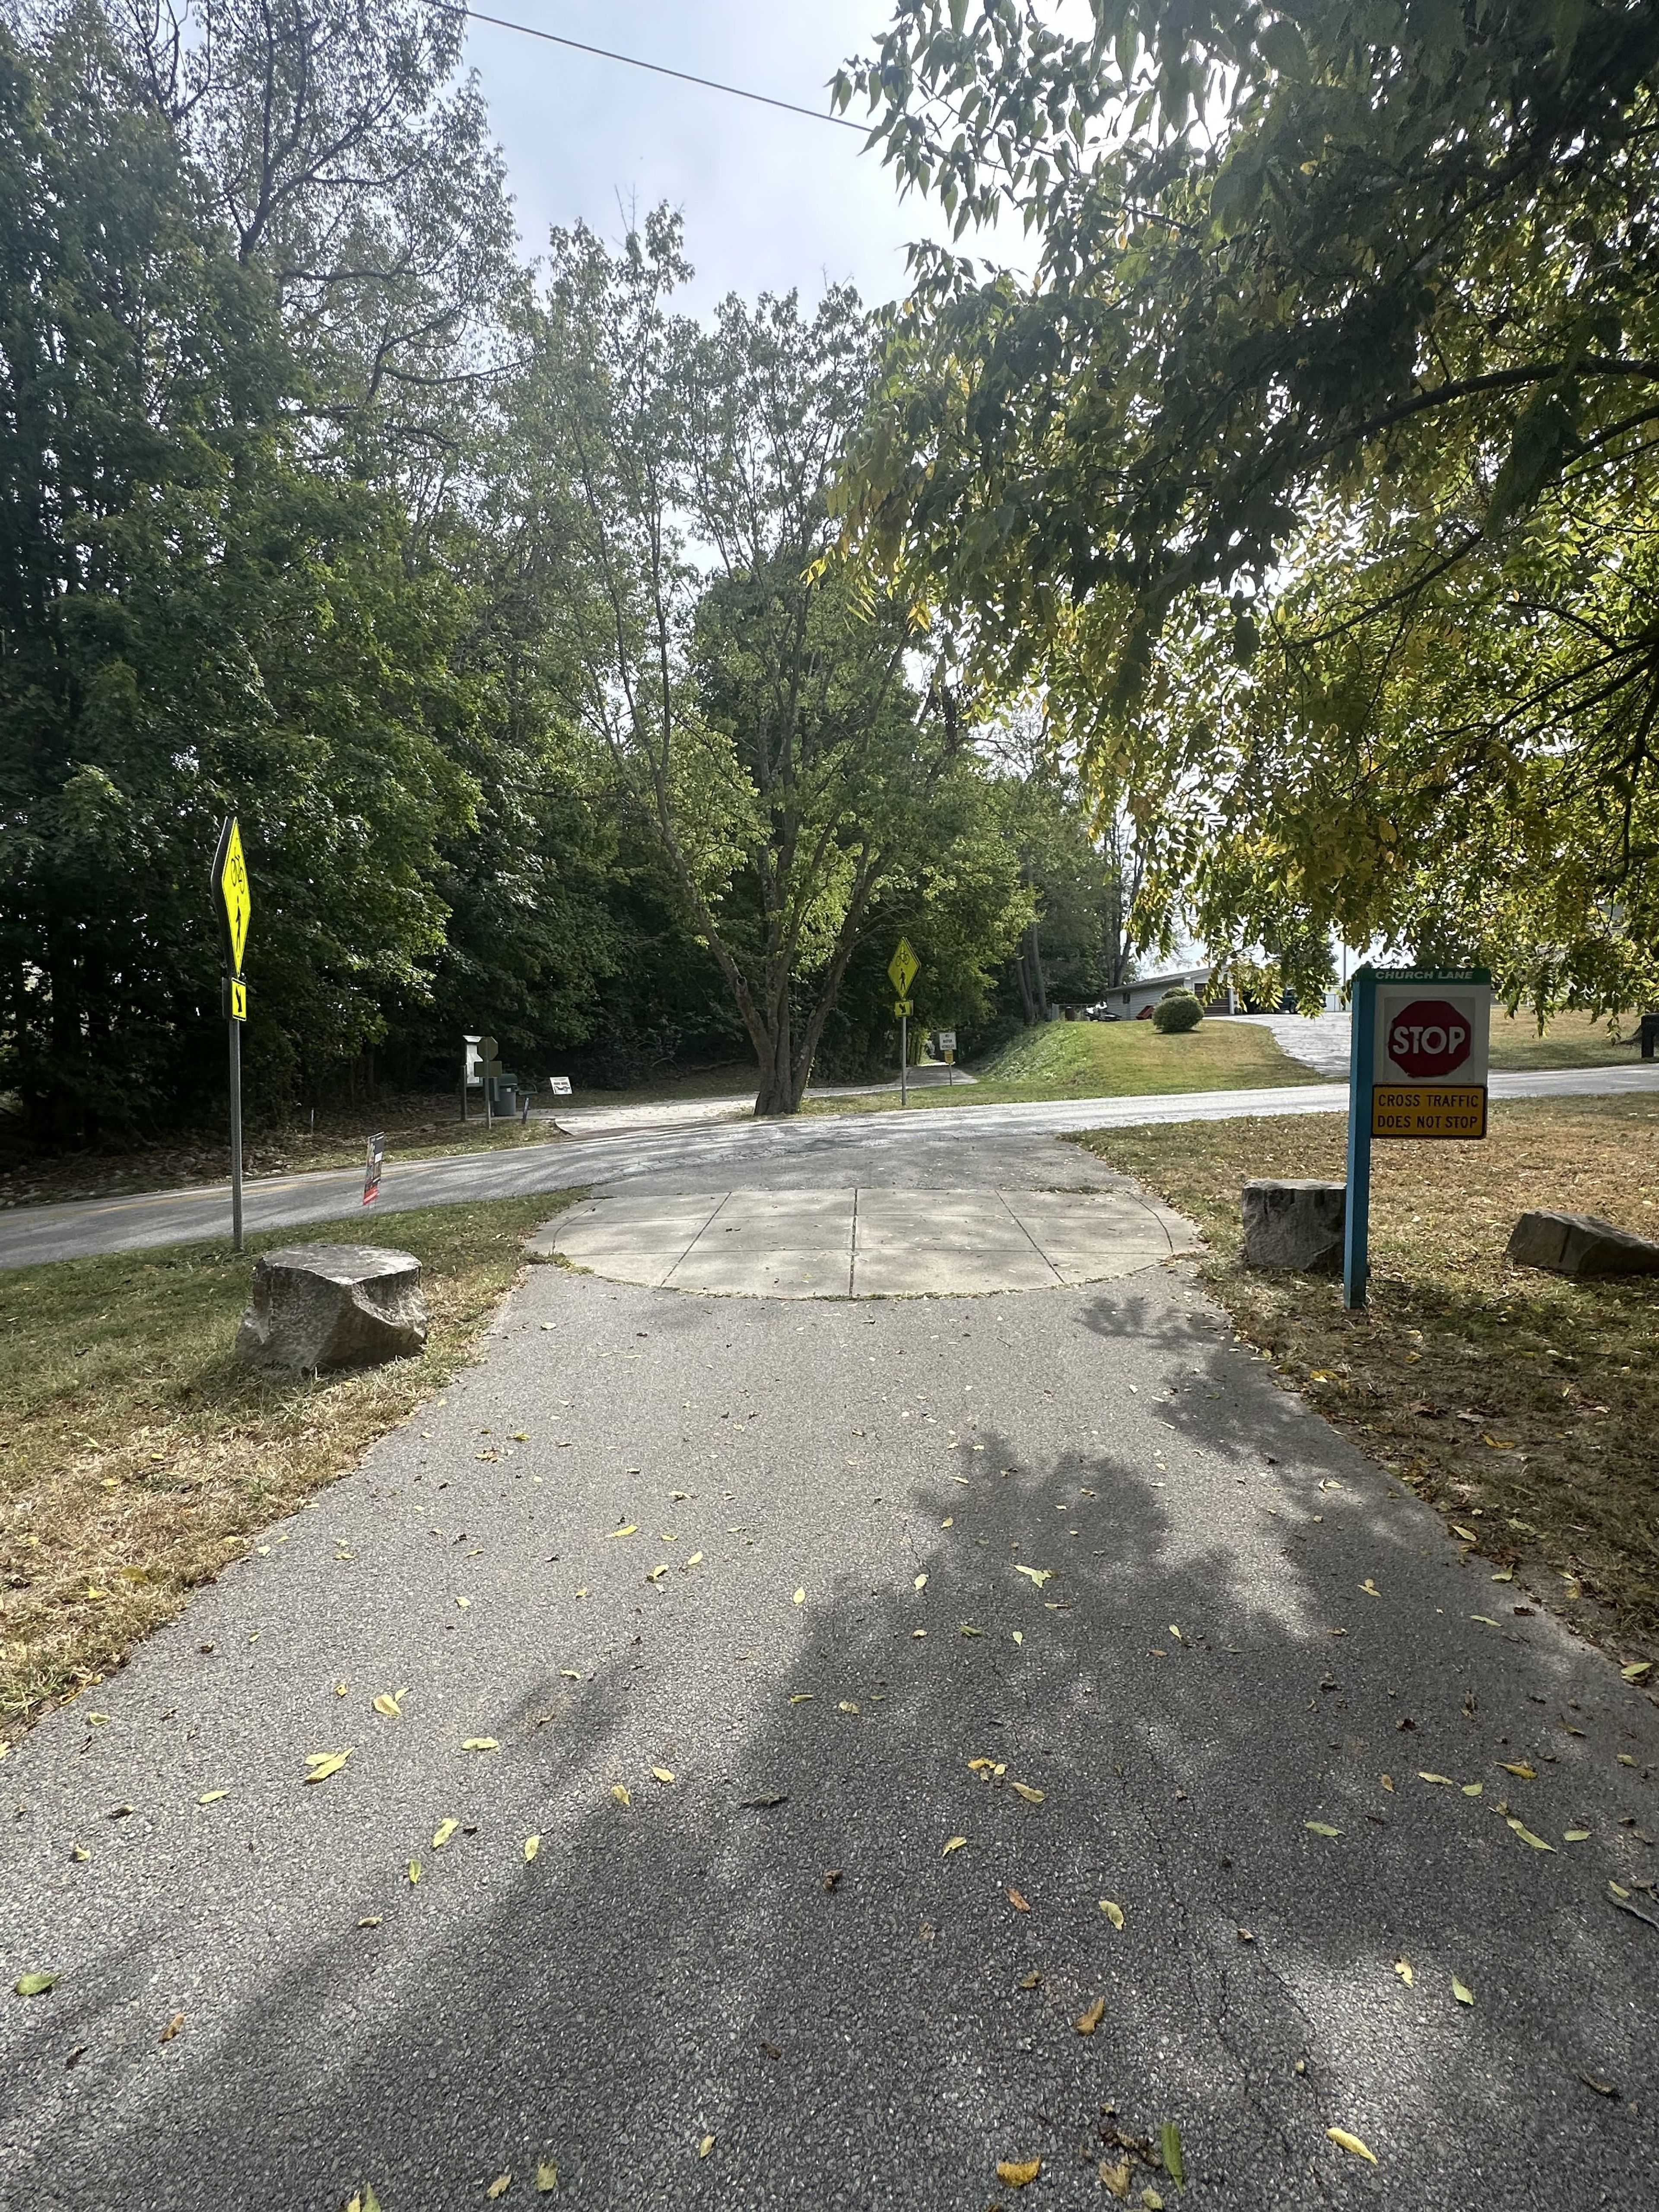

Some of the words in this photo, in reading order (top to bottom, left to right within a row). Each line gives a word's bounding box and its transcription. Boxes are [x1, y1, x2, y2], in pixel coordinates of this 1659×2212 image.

[1375, 971, 1433, 979] CHURCH
[1437, 971, 1474, 979] LANE
[1392, 1026, 1465, 1055] STOP
[1378, 1094, 1421, 1107] CROSS
[1426, 1094, 1479, 1108] TRAFFIC
[1377, 1115, 1411, 1128] DOES
[1416, 1116, 1442, 1128] NOT
[1445, 1116, 1478, 1128] STOP
